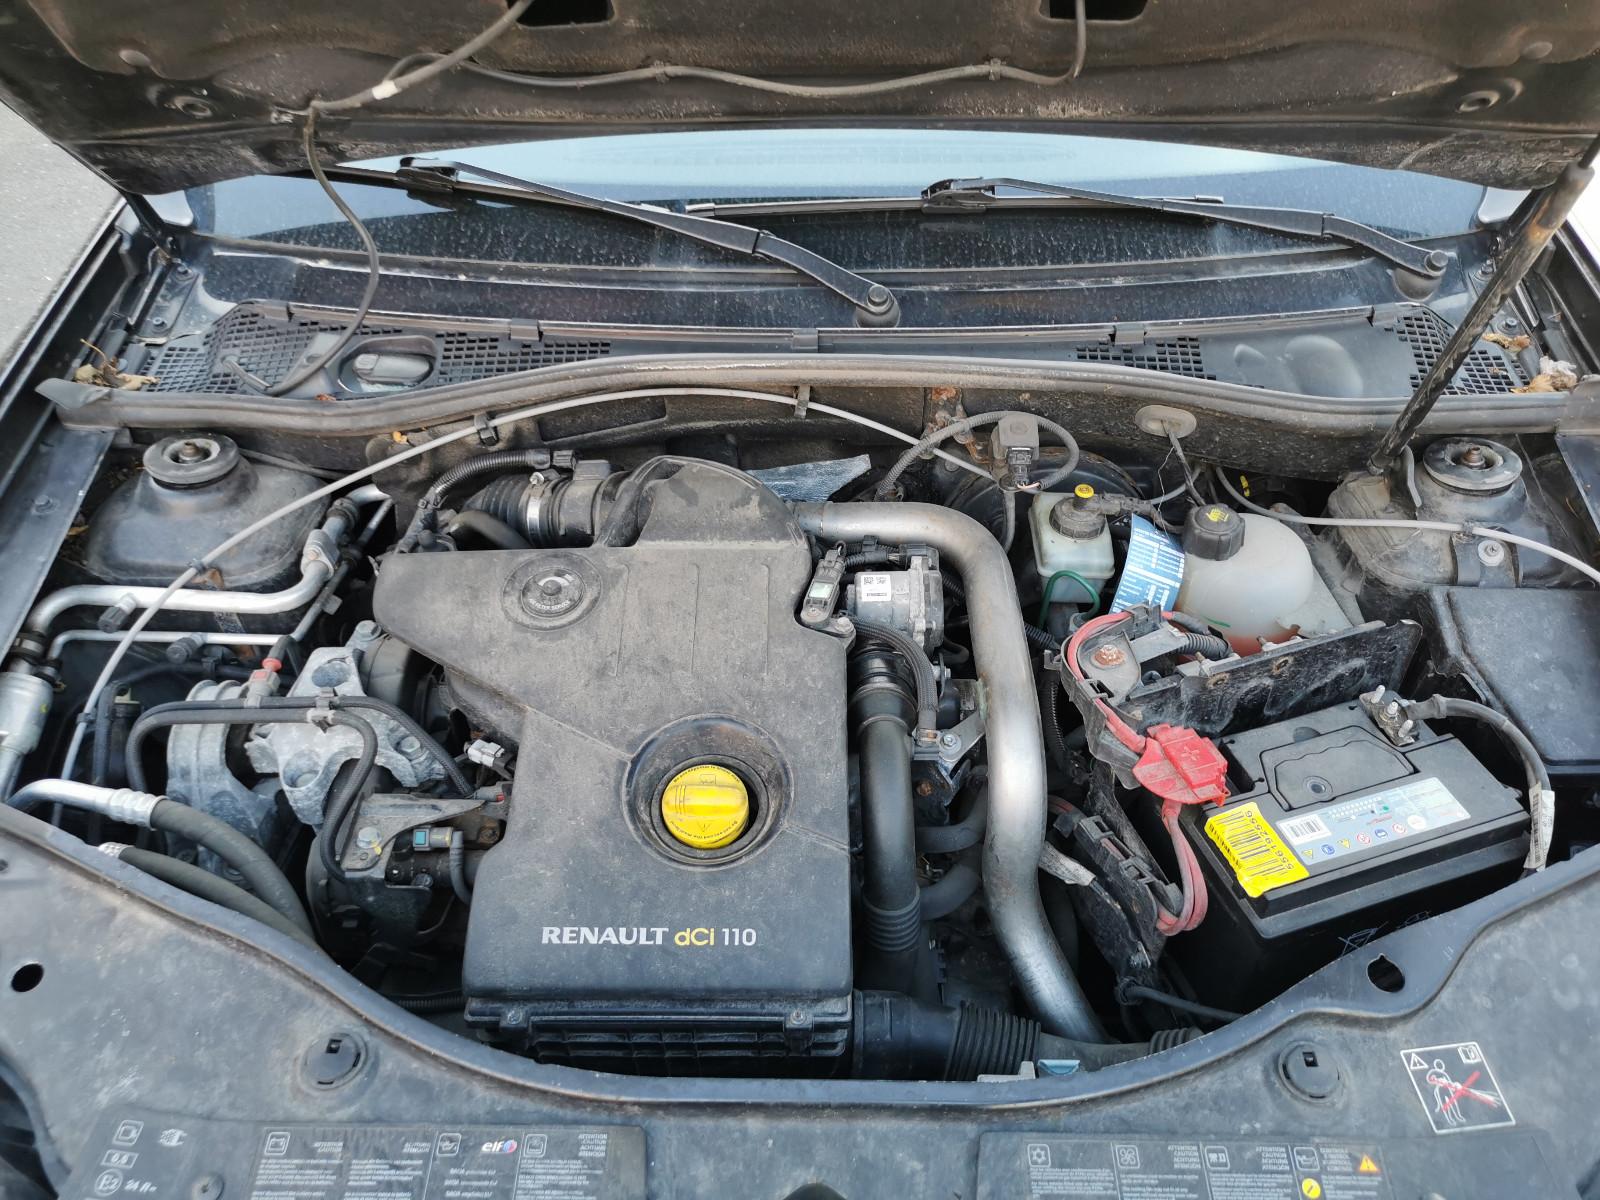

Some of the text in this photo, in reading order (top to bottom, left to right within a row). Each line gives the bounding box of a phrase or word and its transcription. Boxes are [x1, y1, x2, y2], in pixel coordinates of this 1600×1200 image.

[1245, 810, 1294, 870] 556192556
[541, 926, 757, 946] RENAULT dCi 110
[480, 1140, 505, 1152] elf
